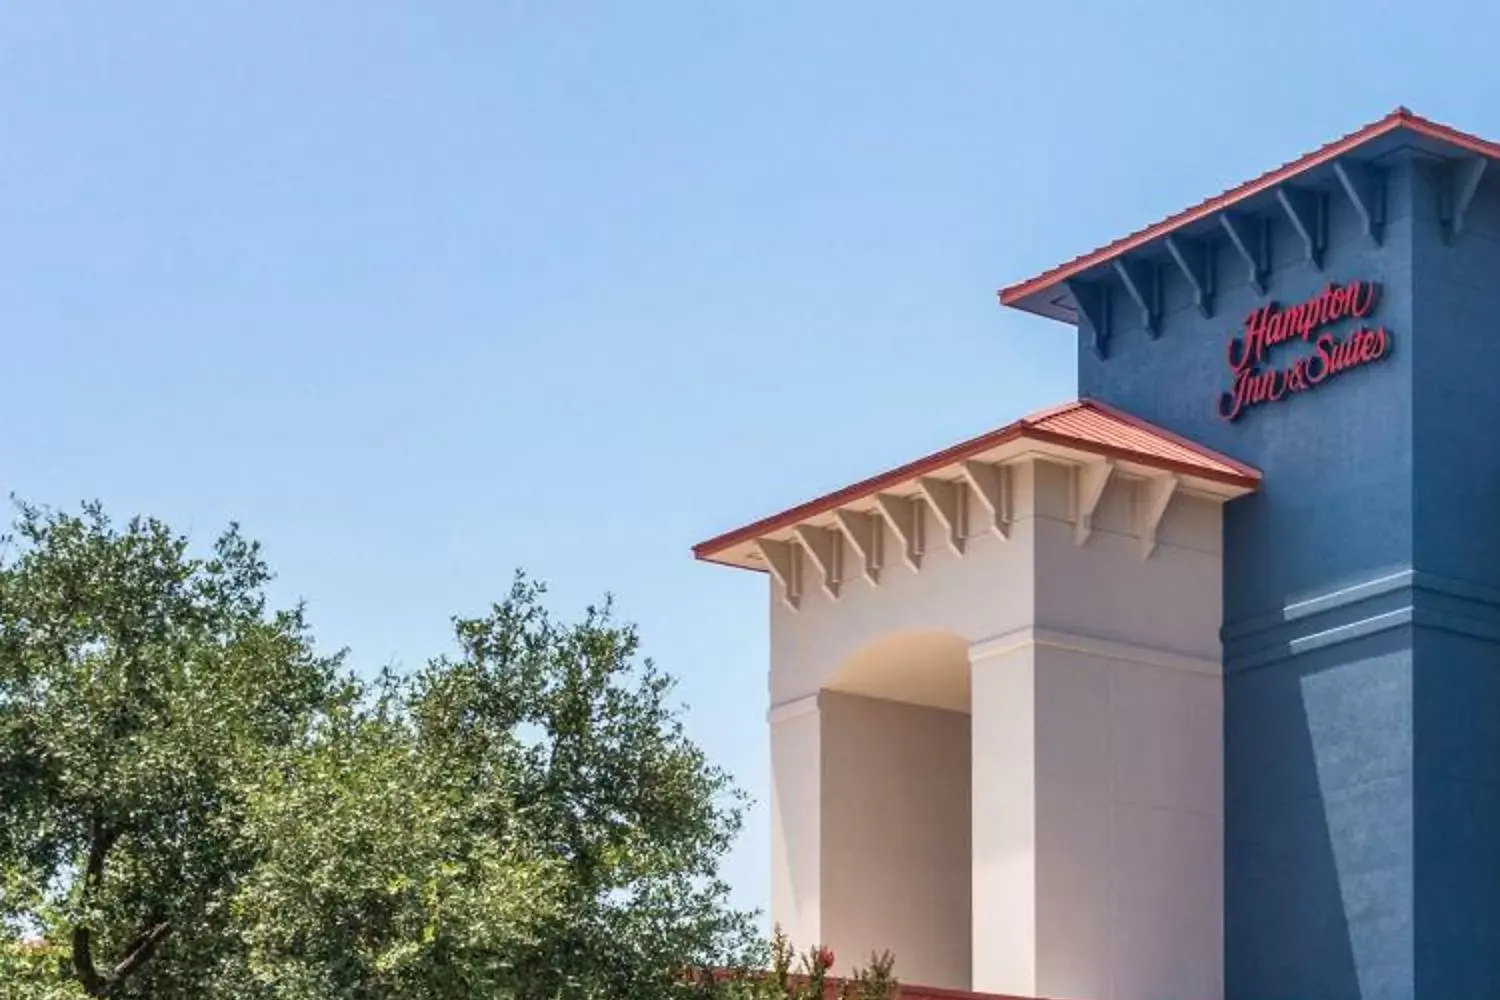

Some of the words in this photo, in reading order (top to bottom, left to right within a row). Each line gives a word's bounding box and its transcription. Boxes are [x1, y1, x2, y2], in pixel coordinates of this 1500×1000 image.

[1227, 280, 1375, 372] Hampton
[1218, 366, 1288, 421] Inn
[1286, 359, 1309, 391] &
[1305, 326, 1387, 383] Suites
